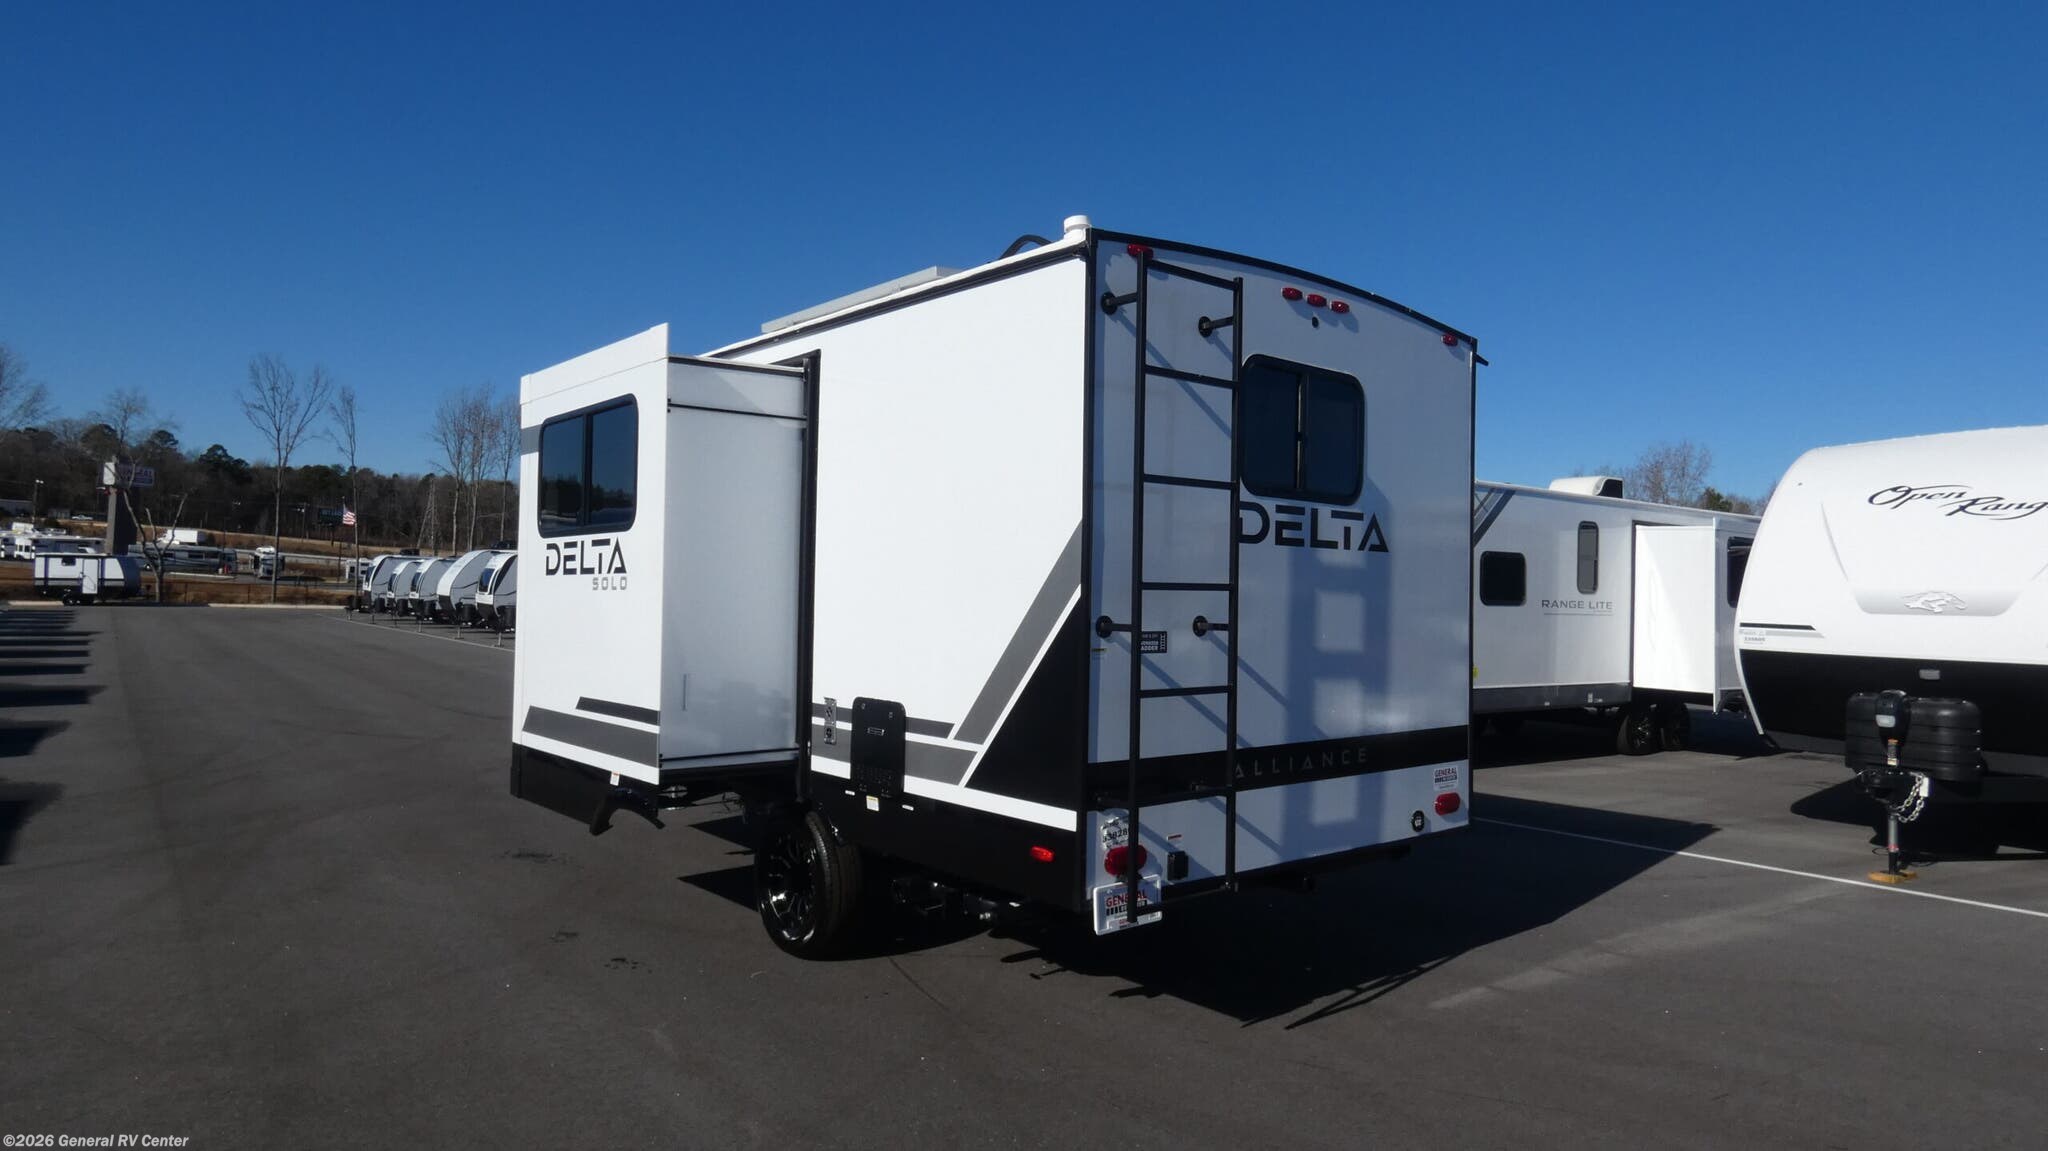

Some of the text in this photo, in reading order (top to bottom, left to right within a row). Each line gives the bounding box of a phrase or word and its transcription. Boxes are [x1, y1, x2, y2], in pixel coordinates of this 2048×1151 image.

[1868, 484, 2048, 521] Open Rang
[1237, 500, 1390, 553] DELTA
[545, 536, 627, 576] DELTA
[592, 576, 628, 591] SOLO
[1541, 599, 1614, 610] RANGE LITE
[1234, 747, 1368, 779] ALLIANCE
[1105, 890, 1149, 908] GENEAL
